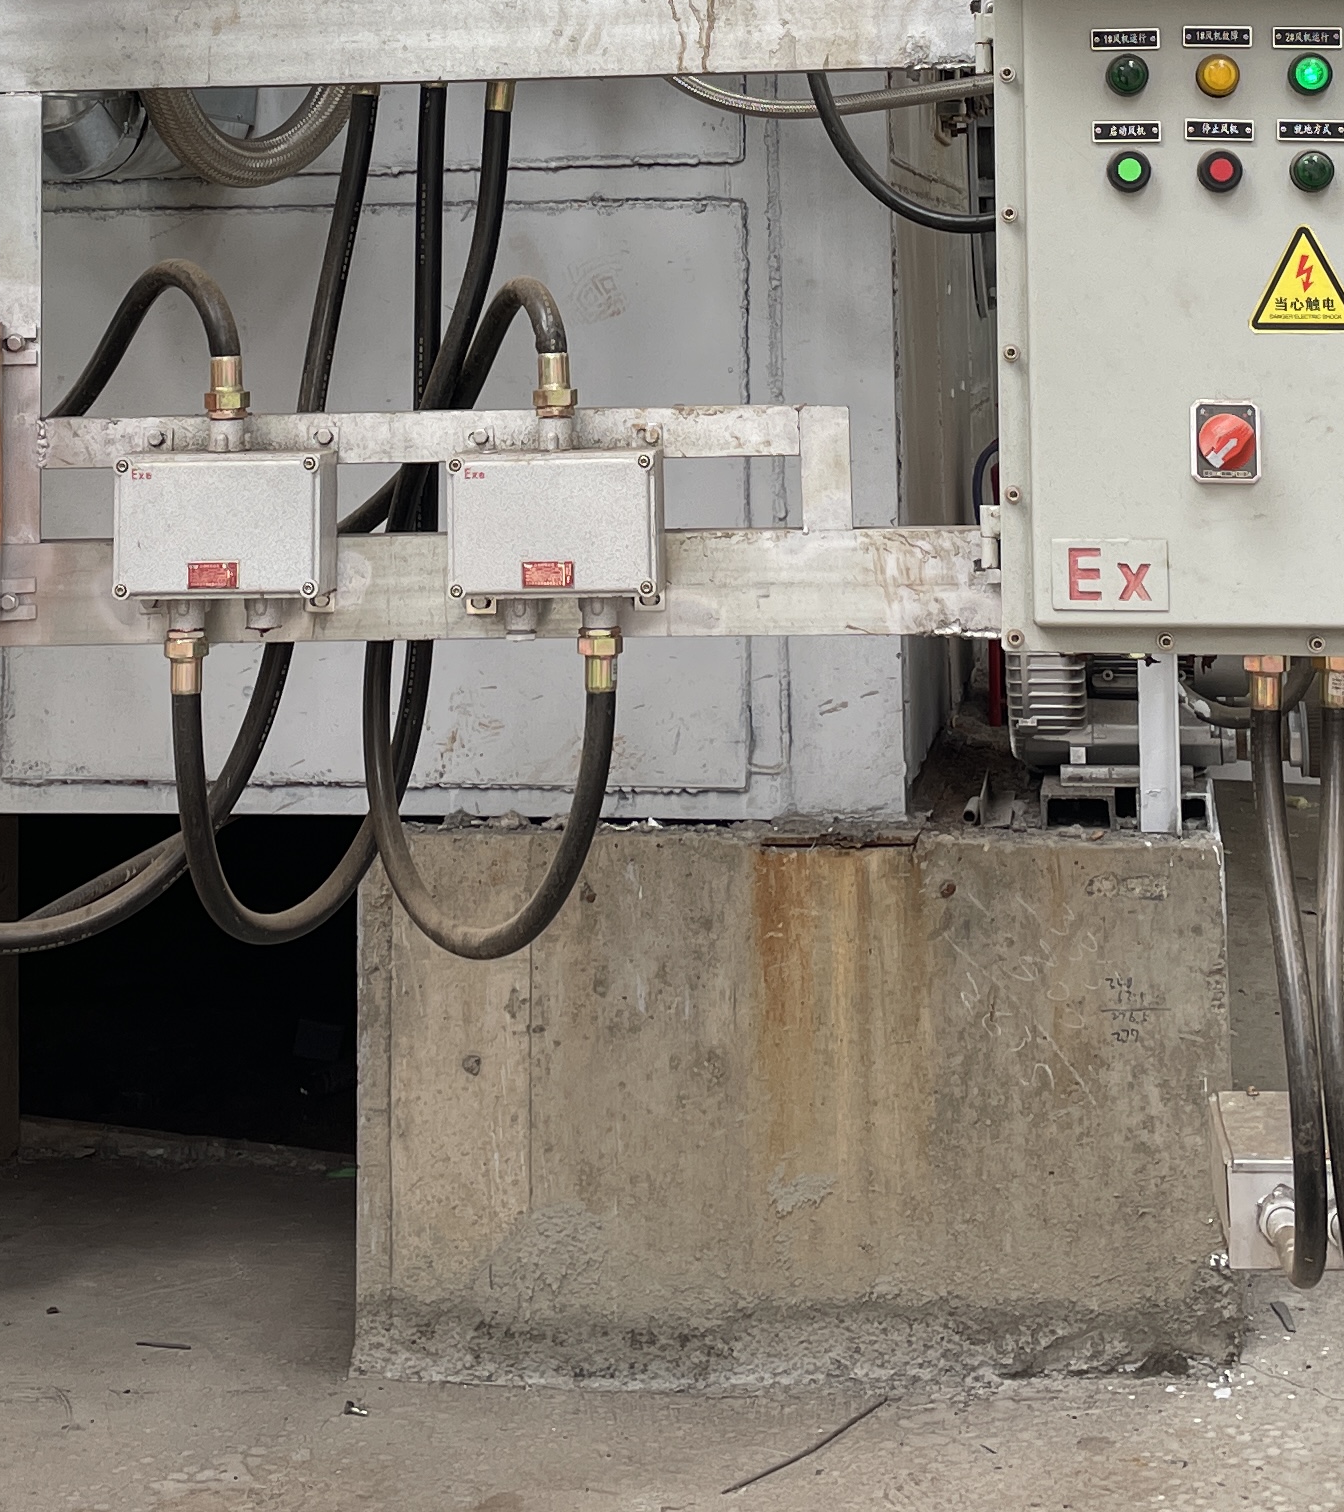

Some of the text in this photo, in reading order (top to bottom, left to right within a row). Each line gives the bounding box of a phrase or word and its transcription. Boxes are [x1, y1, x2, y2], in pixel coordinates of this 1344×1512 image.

[1108, 125, 1147, 137] 启动风机
[1201, 122, 1239, 135] 停止风机
[1293, 123, 1332, 136] 就地方式
[1275, 296, 1336, 312] 当心触电
[1067, 546, 1154, 603] Ex
